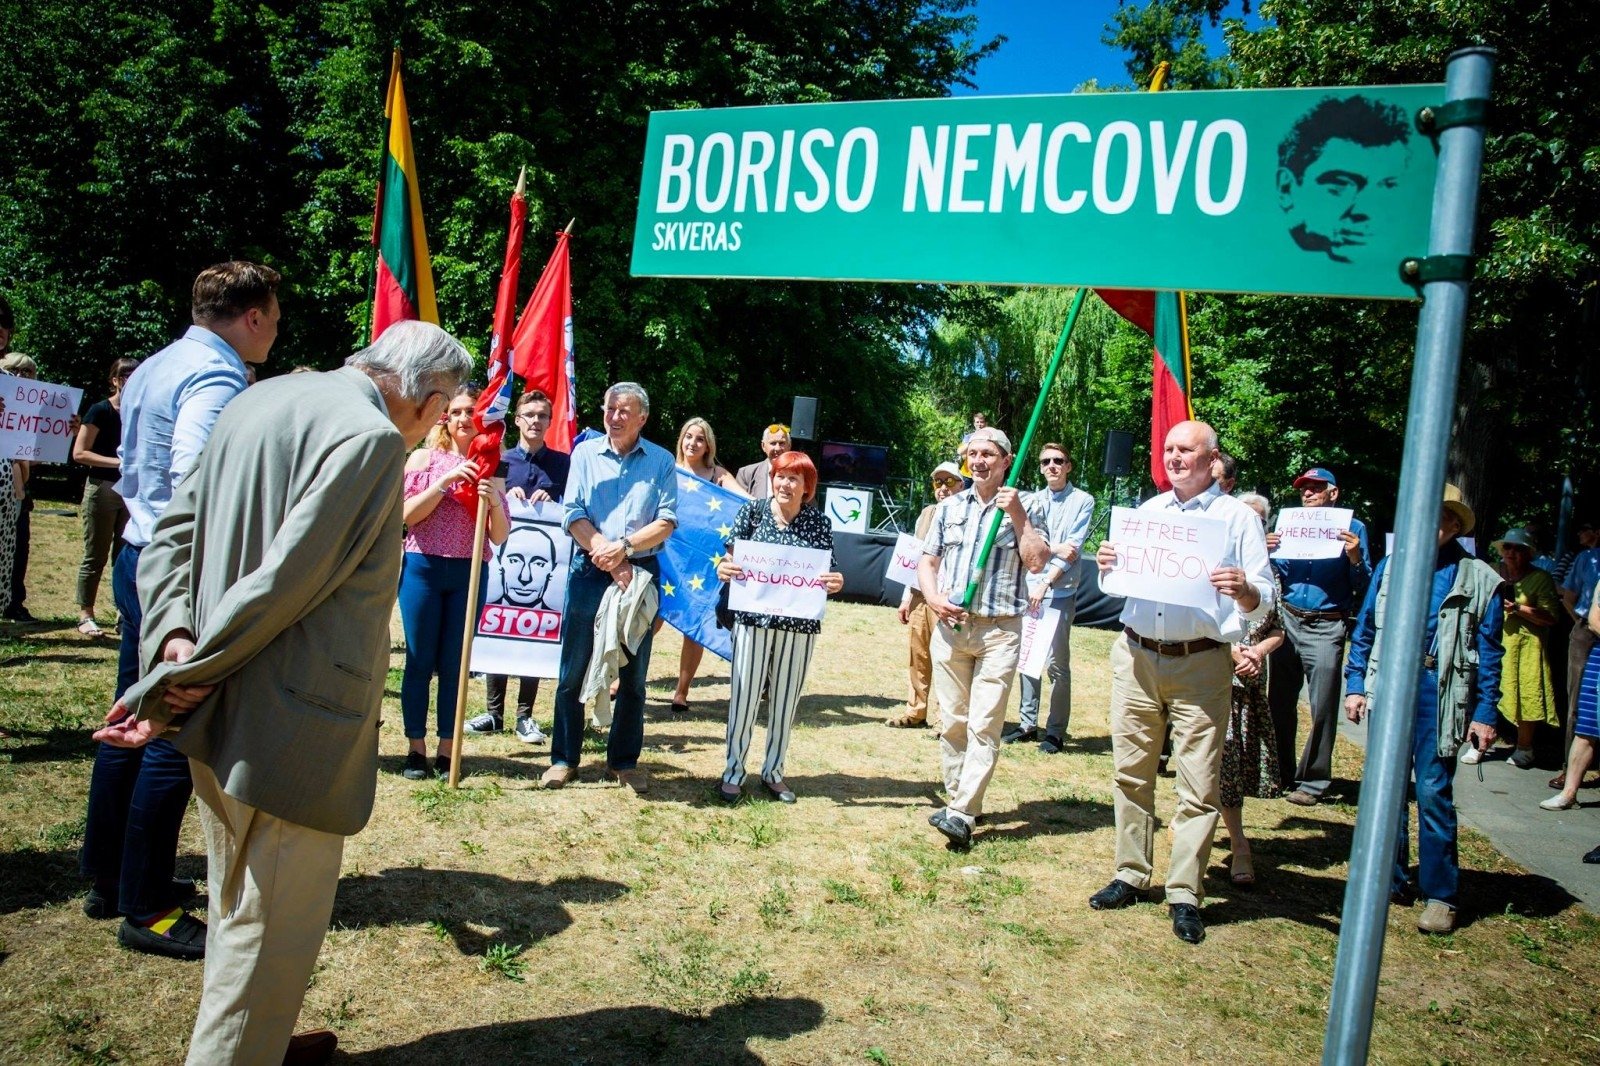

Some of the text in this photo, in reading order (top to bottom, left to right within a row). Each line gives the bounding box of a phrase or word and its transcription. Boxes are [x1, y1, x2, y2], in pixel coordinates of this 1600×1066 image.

[656, 118, 1248, 216] BORISO NEMCOVO
[652, 221, 743, 251] SKVERAS
[16, 386, 68, 409] BORIS
[1292, 511, 1332, 521] PAVEL
[1121, 517, 1198, 543] #FREE
[742, 554, 815, 571] ANASTASIA
[735, 569, 825, 590] BABUROVA
[481, 607, 559, 637] STOP
